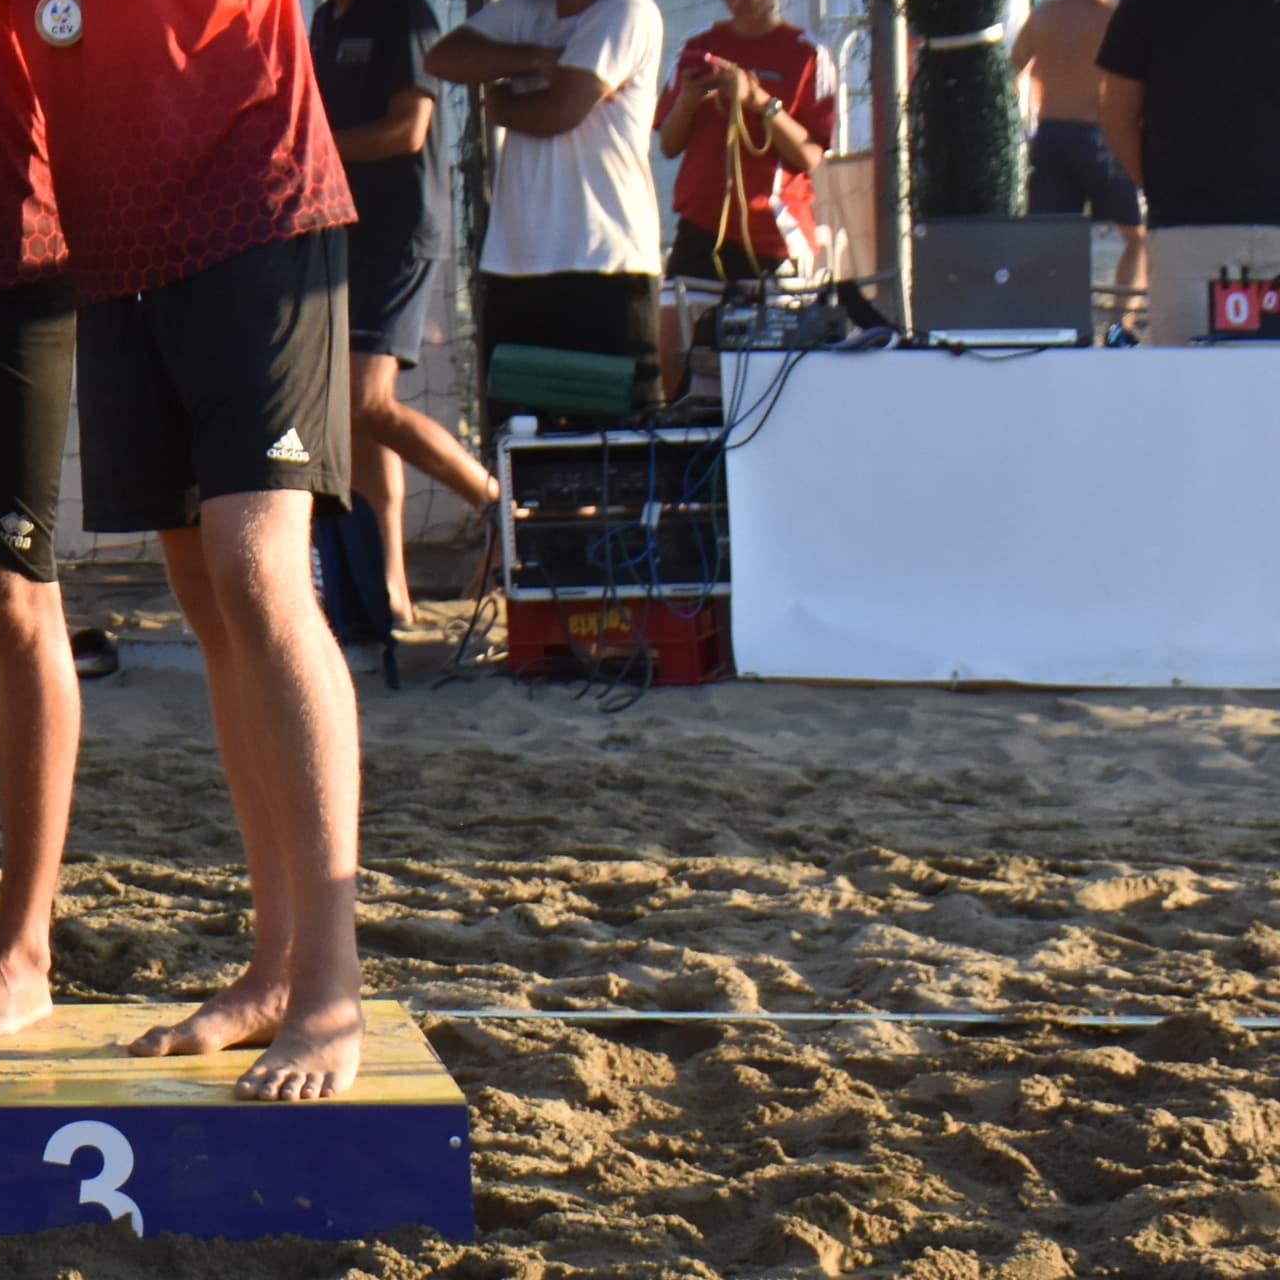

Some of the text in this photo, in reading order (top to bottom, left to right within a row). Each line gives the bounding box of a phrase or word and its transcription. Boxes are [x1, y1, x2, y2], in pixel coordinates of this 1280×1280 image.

[51, 25, 74, 35] CEV
[1225, 291, 1249, 325] 0
[266, 448, 310, 463] adidas
[42, 1120, 145, 1238] 3
